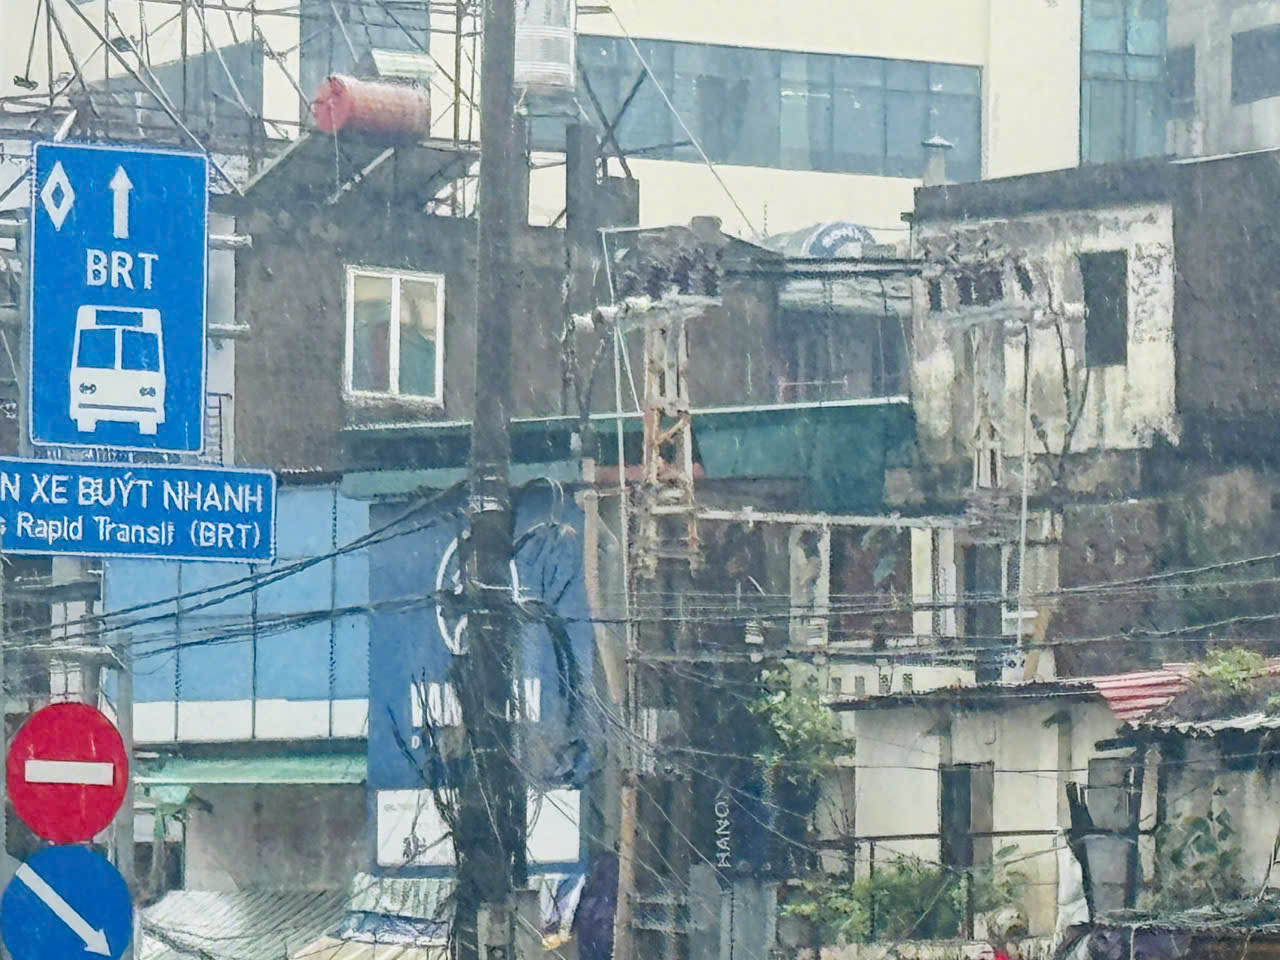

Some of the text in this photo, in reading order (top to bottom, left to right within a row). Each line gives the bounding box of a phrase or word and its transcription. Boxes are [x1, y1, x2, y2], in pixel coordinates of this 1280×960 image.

[86, 248, 159, 291] BRT
[31, 472, 69, 505] XE
[78, 471, 153, 509] BUÝT
[163, 479, 264, 514] NHANH
[16, 511, 84, 545] Rapid
[190, 519, 261, 549] (BRT)
